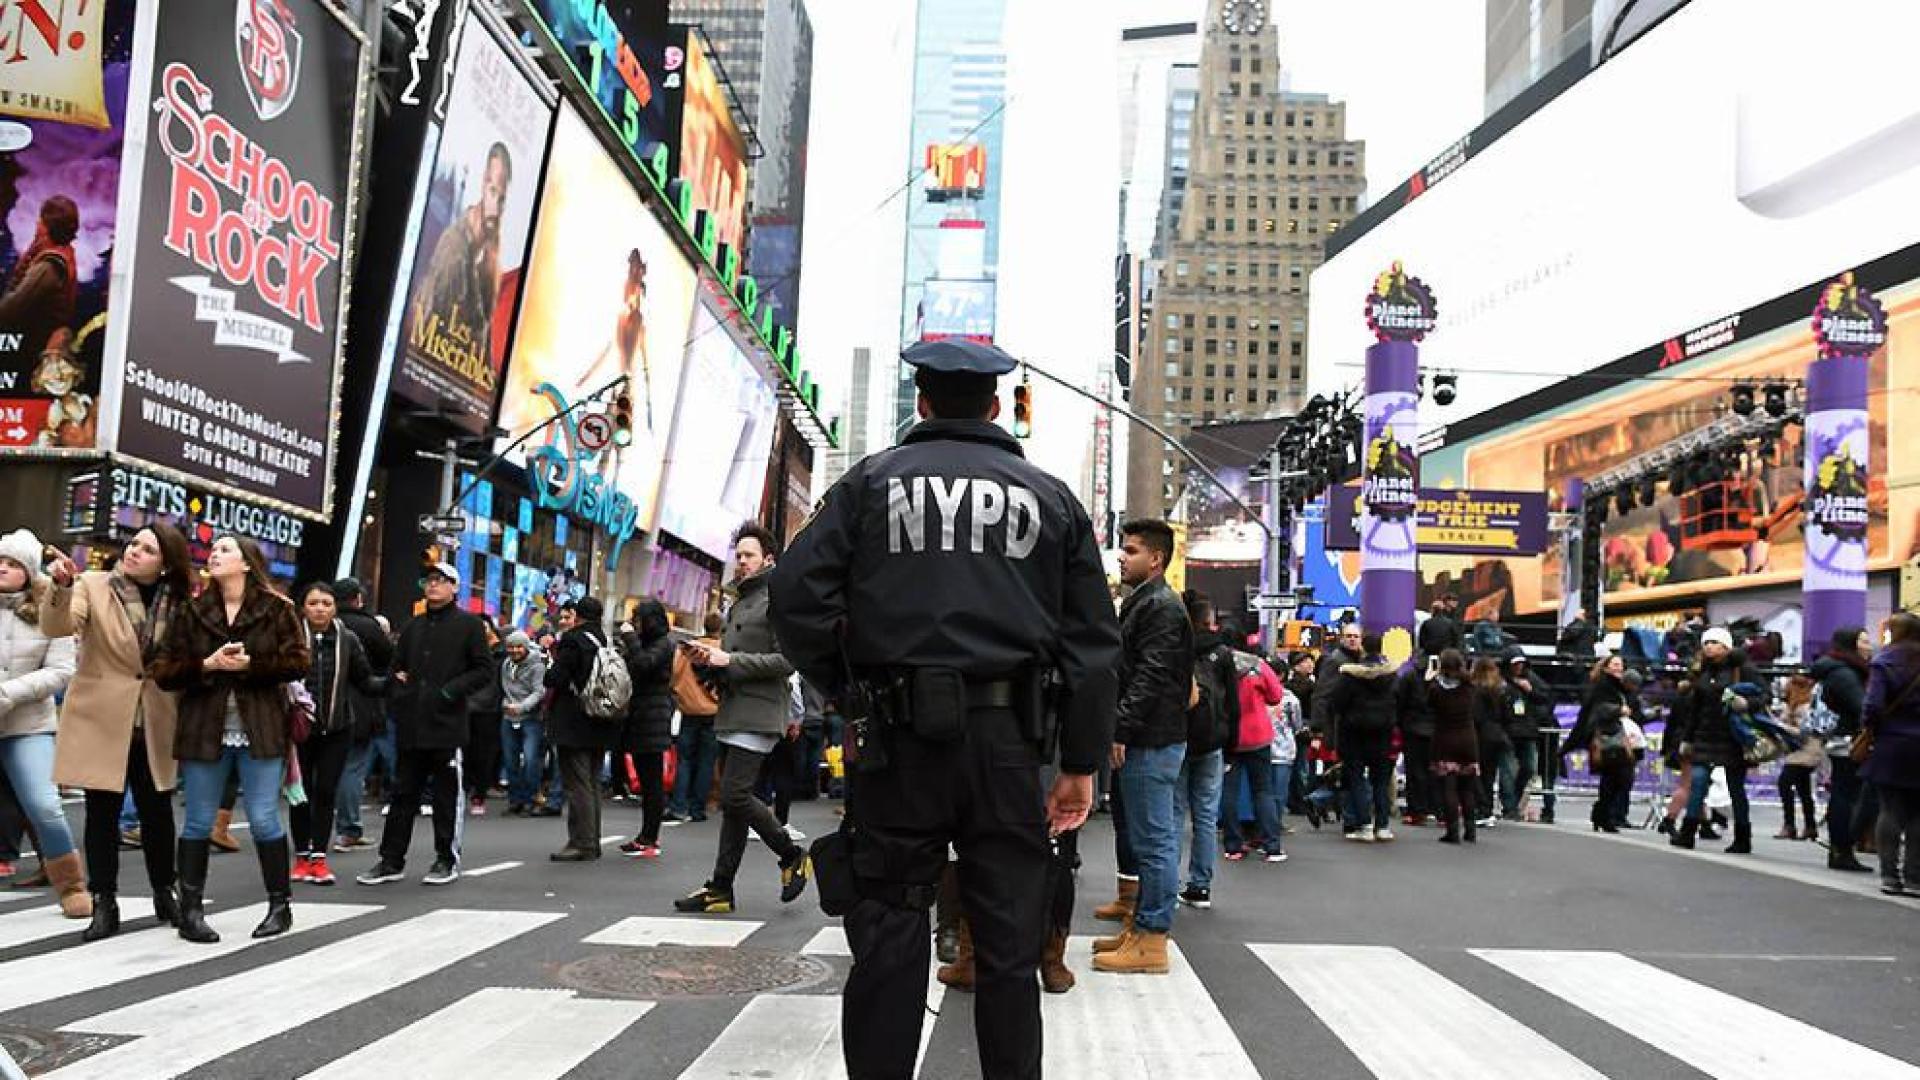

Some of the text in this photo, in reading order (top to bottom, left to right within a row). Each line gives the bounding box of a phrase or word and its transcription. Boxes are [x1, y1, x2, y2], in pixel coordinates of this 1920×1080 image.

[153, 63, 340, 260] SCHOOL
[164, 154, 329, 333] ROCK
[1372, 301, 1423, 317] planet
[1378, 316, 1432, 329] fitness
[1820, 315, 1874, 331] planet
[1826, 327, 1884, 344] fitness
[125, 360, 324, 457] SchoolOfRockTheMusical.com
[142, 396, 311, 479] WINTER GARDEN THEATRE
[110, 468, 304, 547] GIFTS LUGGAGE
[1415, 500, 1521, 516] UDGEMENT
[887, 475, 1042, 560] NYPD
[1437, 513, 1488, 528] FREE
[1438, 531, 1486, 542] STAGE
